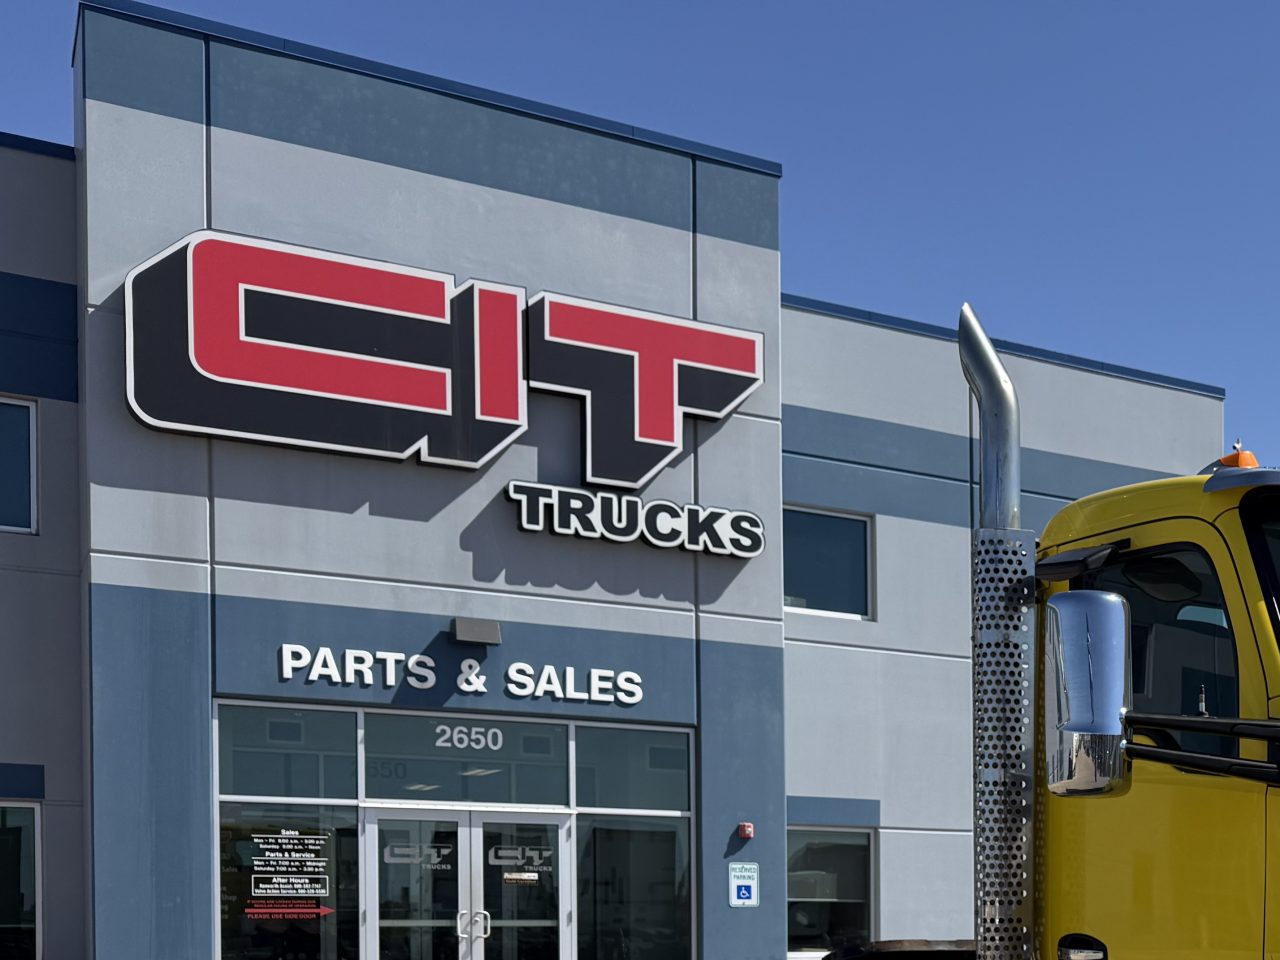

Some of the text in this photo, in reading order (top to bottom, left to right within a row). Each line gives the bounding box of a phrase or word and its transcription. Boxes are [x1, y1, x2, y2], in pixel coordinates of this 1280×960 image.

[125, 229, 765, 488] CIT
[507, 480, 766, 558] TRUCKS
[281, 643, 643, 705] PARTS & SALES
[435, 724, 503, 750] 2650
[384, 843, 453, 863] CIT
[488, 845, 554, 866] CIT
